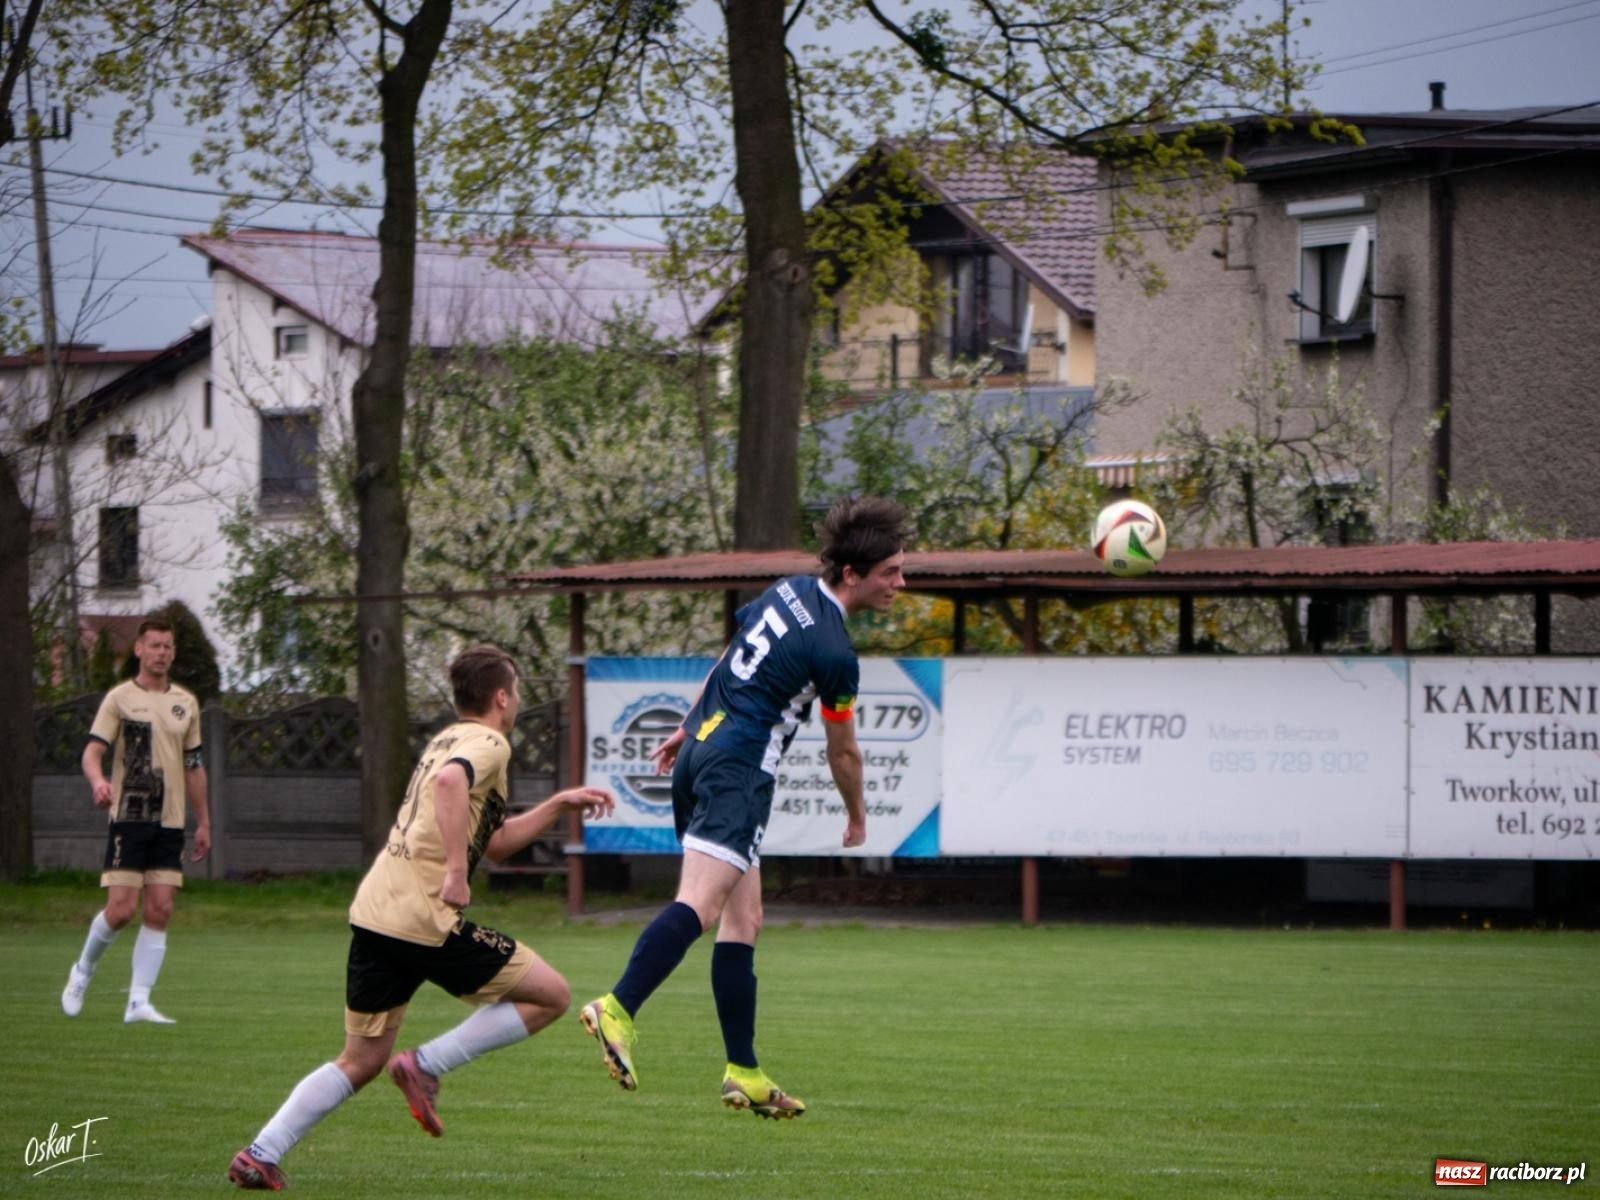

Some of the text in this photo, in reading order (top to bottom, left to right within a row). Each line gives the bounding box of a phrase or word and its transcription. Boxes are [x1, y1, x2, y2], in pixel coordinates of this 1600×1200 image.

[729, 605, 789, 681] 5
[1423, 684, 1600, 715] KAMIENI
[874, 704, 923, 729] 779
[1065, 713, 1187, 740] ELEKTRO
[1465, 722, 1600, 759] Krystian
[1064, 746, 1141, 765] SYSTEM
[1208, 751, 1369, 773] 695 729 902
[883, 775, 903, 792] 17
[1446, 777, 1566, 808] Tworków,
[1497, 811, 1535, 835] tel.
[1542, 813, 1586, 840] 692
